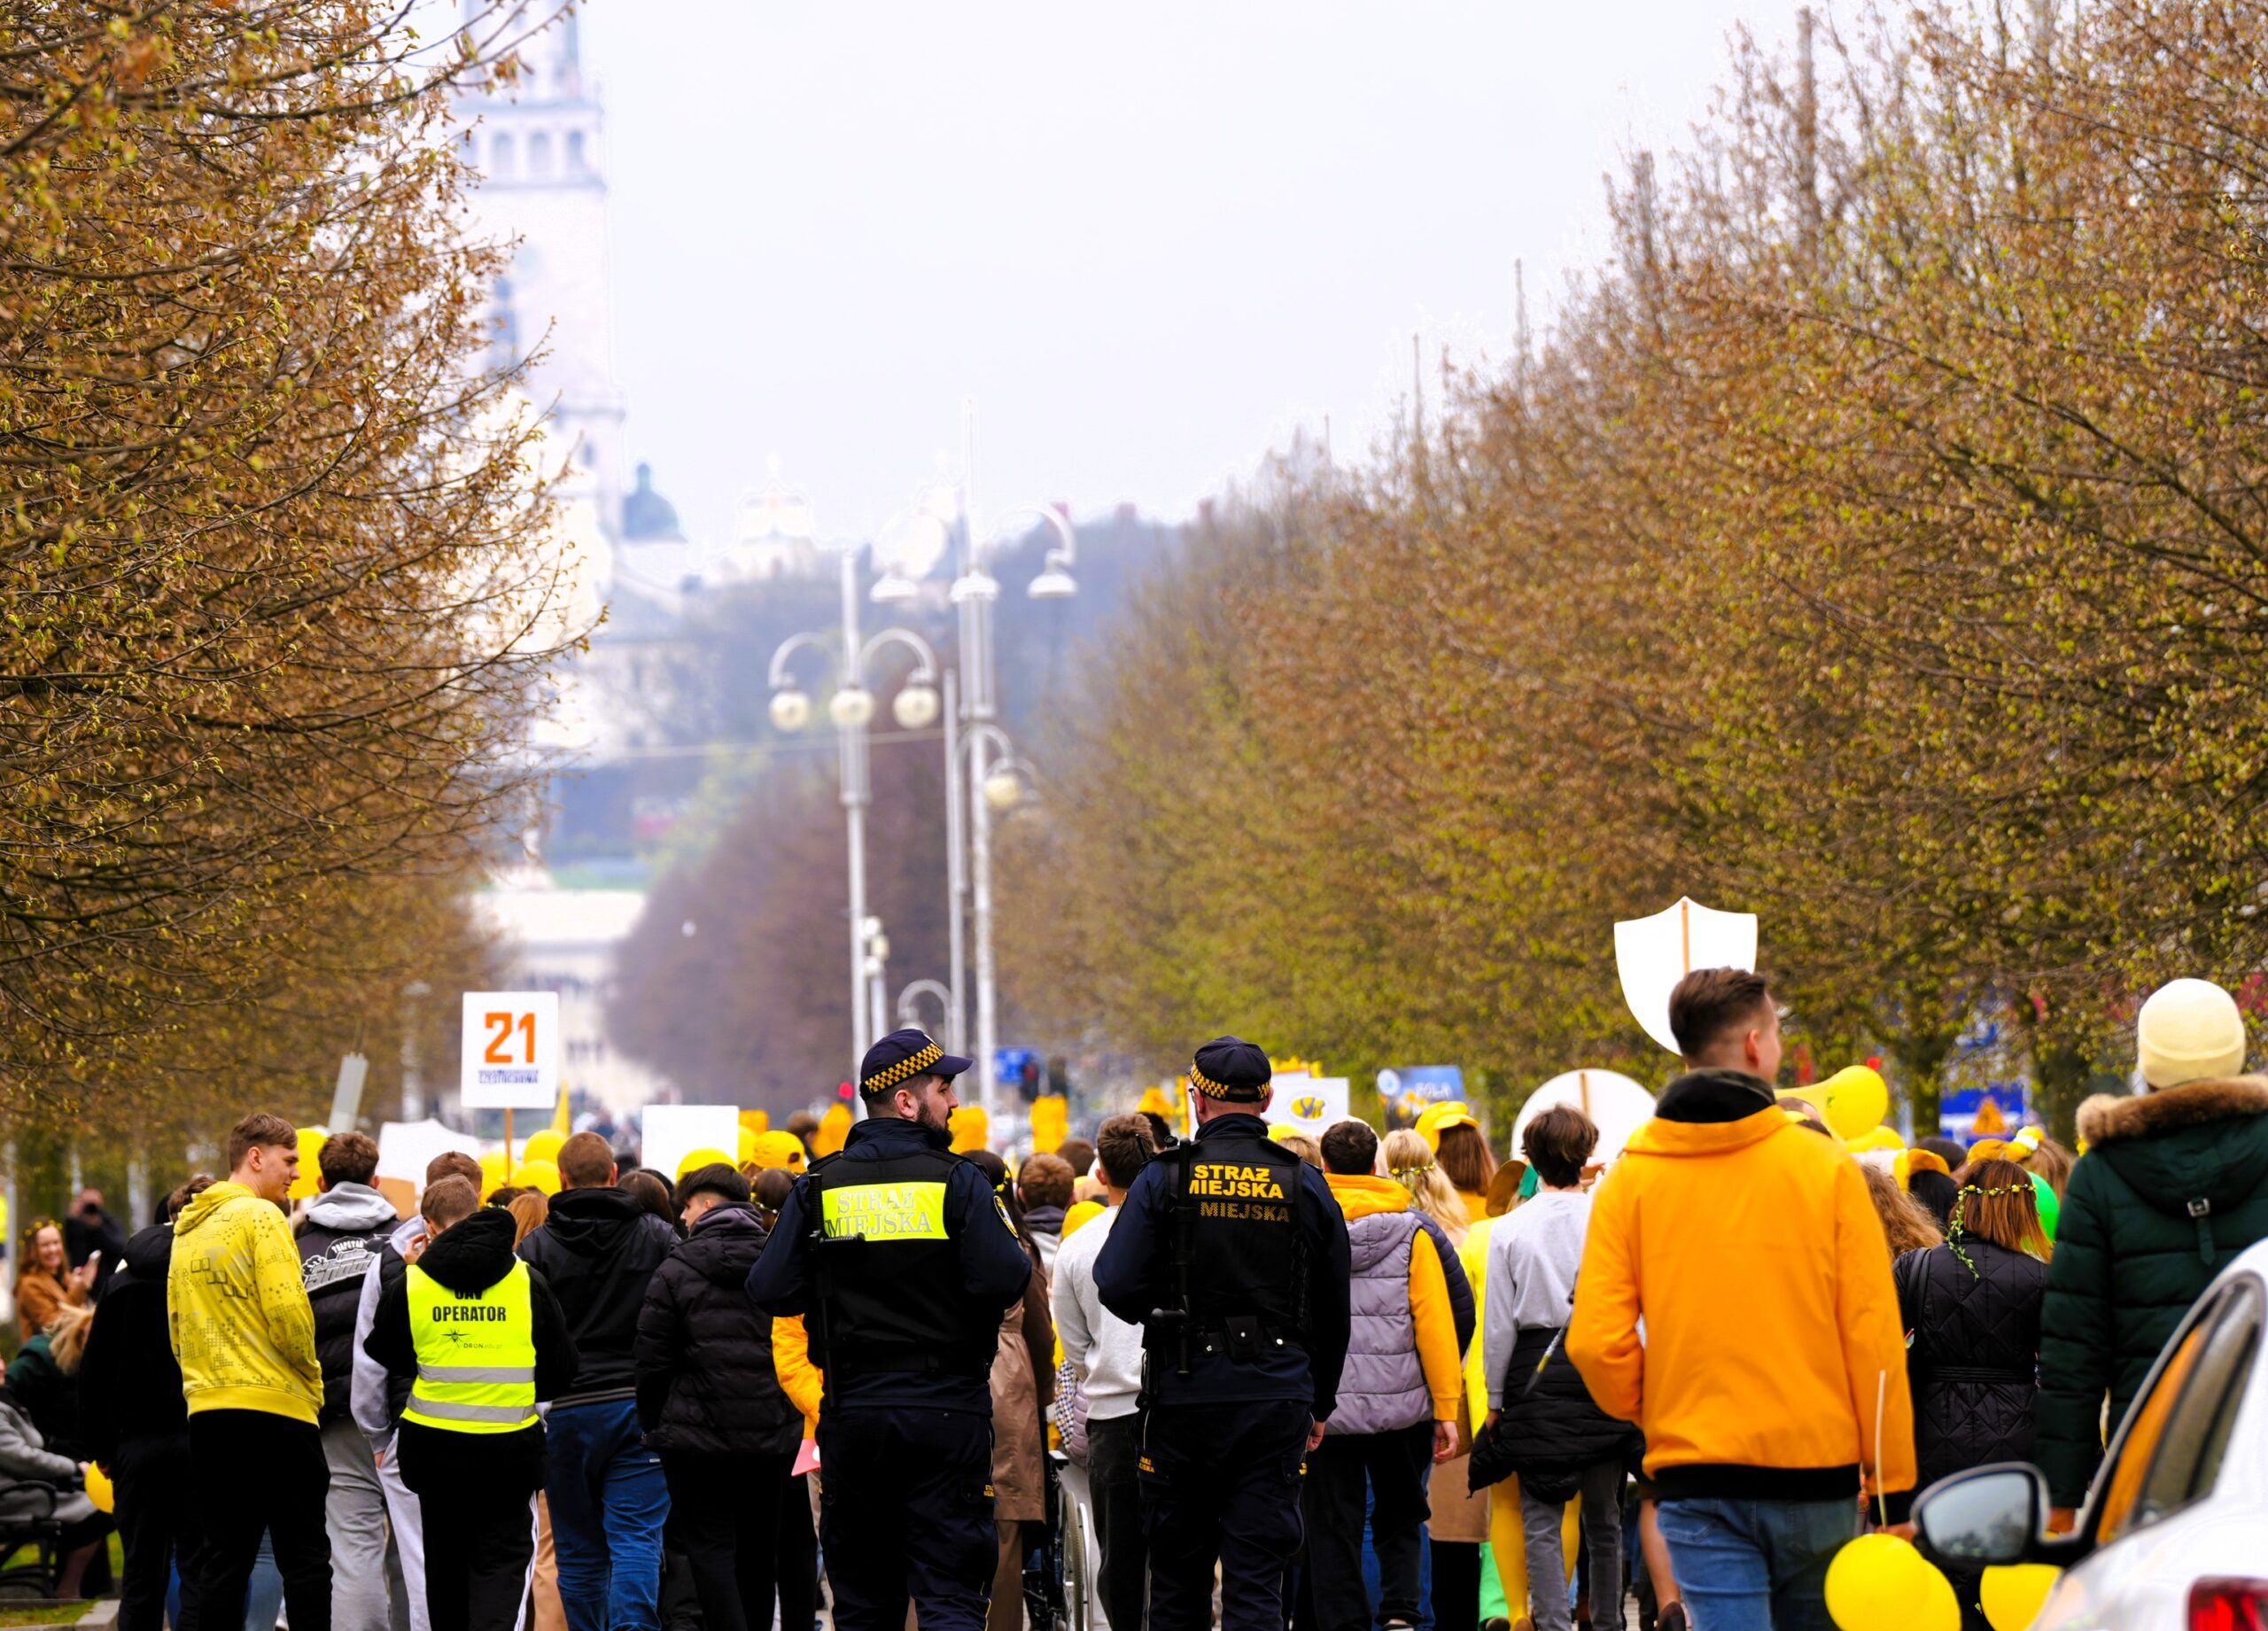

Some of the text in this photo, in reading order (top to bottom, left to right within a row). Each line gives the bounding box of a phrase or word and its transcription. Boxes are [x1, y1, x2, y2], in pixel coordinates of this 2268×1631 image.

[485, 1013, 535, 1063] 21
[1200, 1201, 1290, 1222] MIEJSKA
[825, 1212, 933, 1238] MIEJSKA
[432, 1306, 506, 1322] OPERATOR
